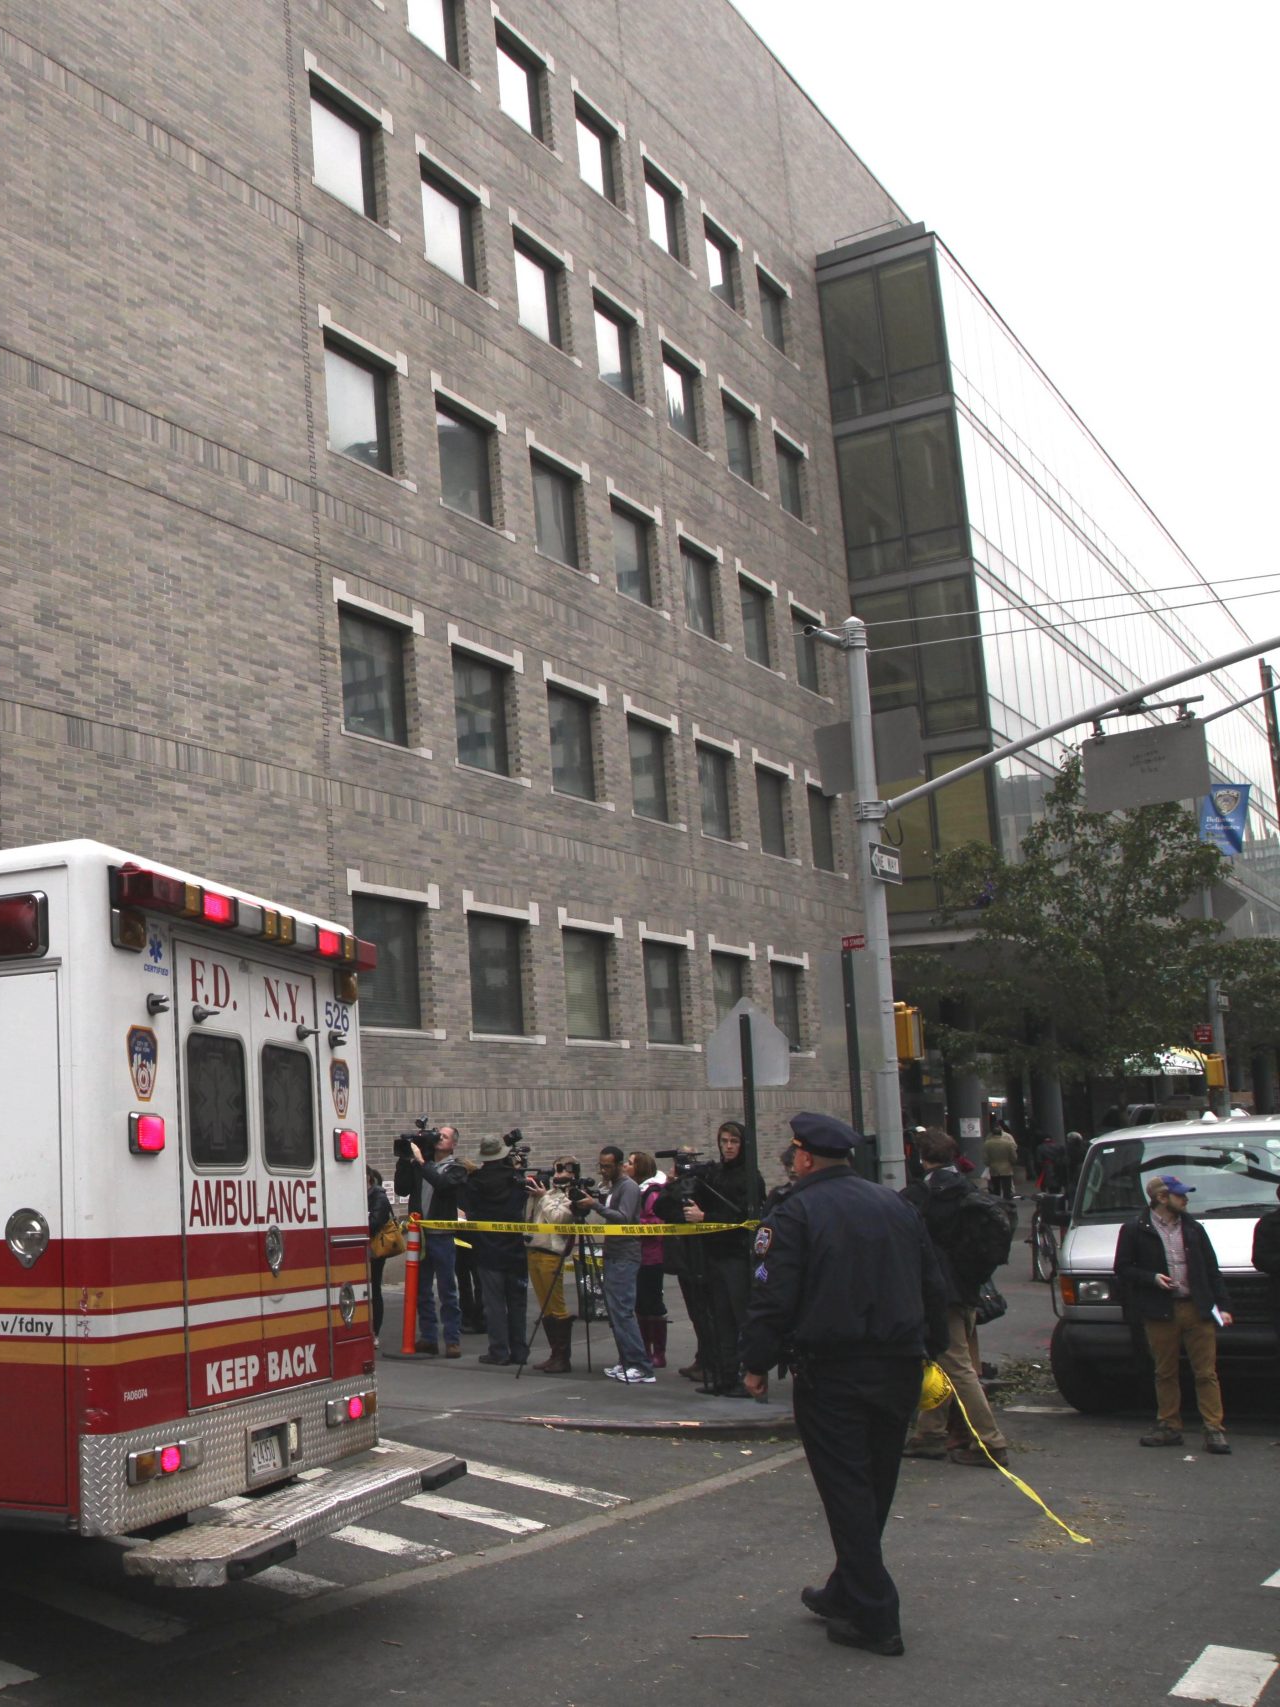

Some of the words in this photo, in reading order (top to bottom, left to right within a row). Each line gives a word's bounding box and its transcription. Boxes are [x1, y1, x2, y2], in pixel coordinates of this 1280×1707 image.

[874, 853, 885, 869] ONE
[887, 857, 897, 873] WAY
[143, 963, 169, 976] CERTIFIED
[190, 957, 237, 1011] F.D.
[263, 976, 305, 1025] N.Y.
[325, 1001, 350, 1032] 526
[189, 1179, 318, 1227] AMBULANCE
[554, 1225, 567, 1233] POLICE
[621, 1226, 635, 1234] POLICE
[206, 1355, 260, 1396] KEEP
[267, 1343, 317, 1383] BACK
